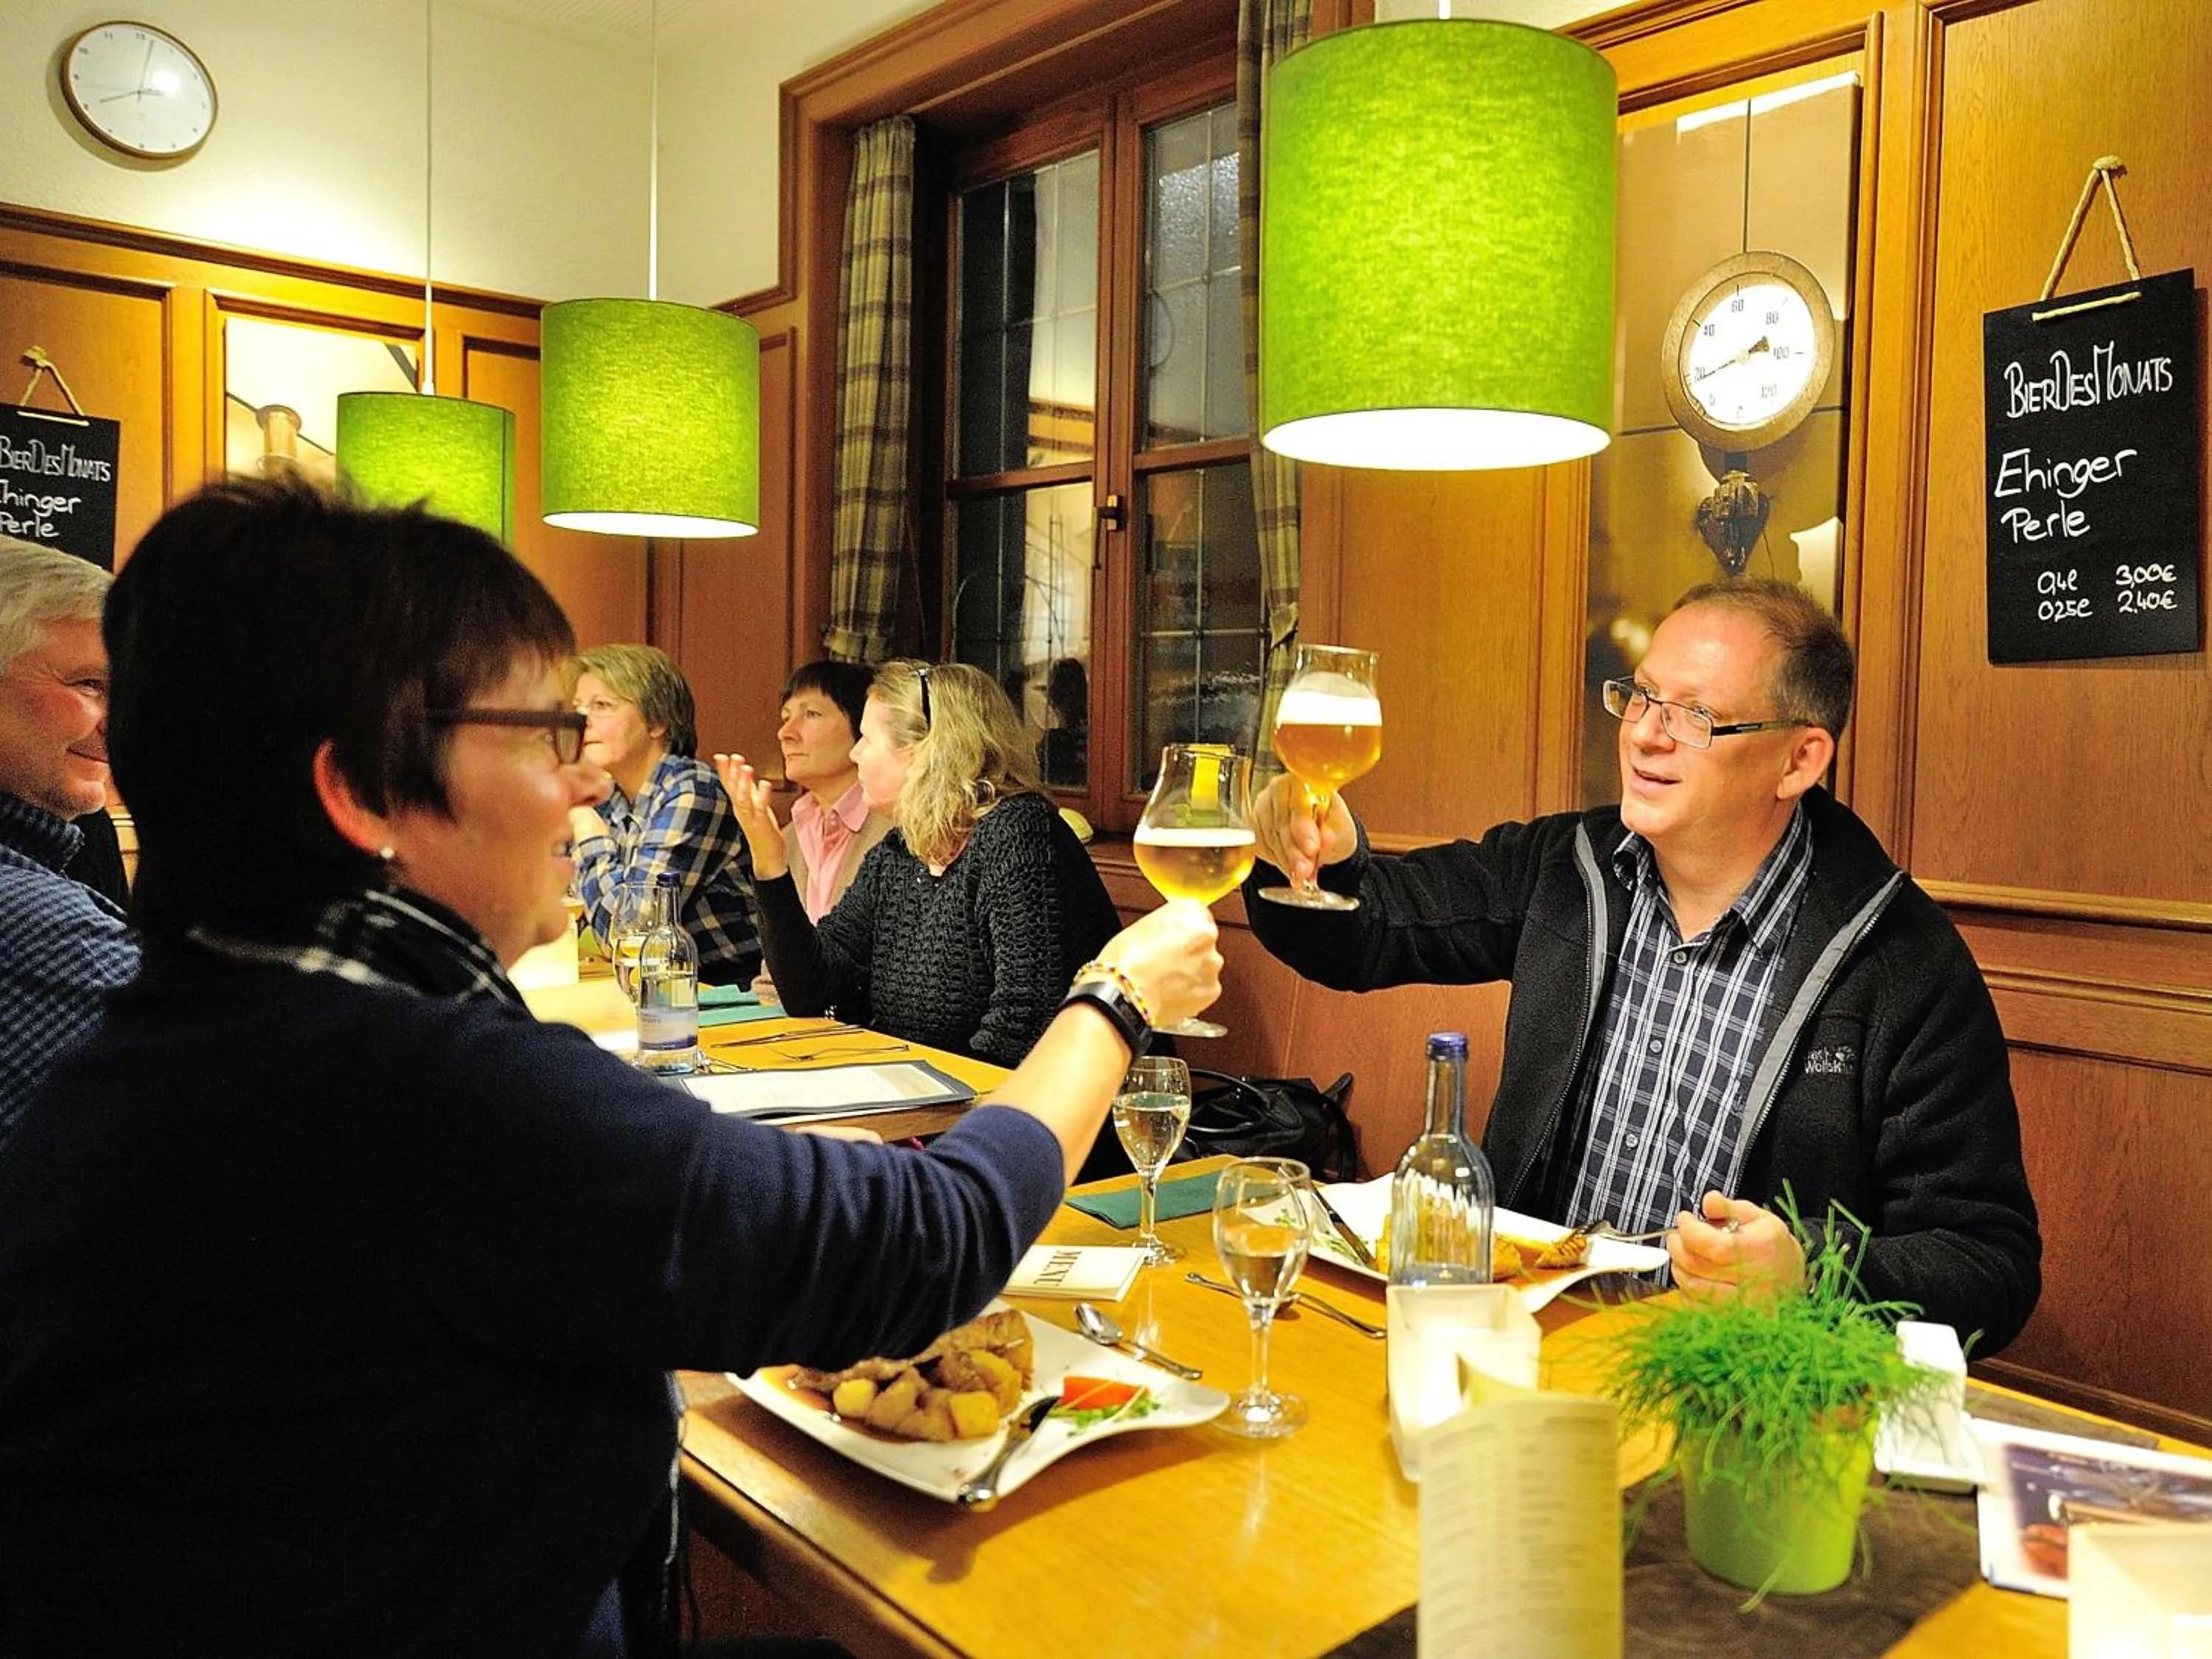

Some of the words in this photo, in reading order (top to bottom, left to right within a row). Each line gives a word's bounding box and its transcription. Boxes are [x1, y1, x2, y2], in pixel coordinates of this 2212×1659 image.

[1994, 448, 2138, 498] Ehinger
[2000, 499, 2090, 543] Perle
[2115, 563, 2177, 589] 3,00€
[1033, 1249, 1083, 1287] MENU
